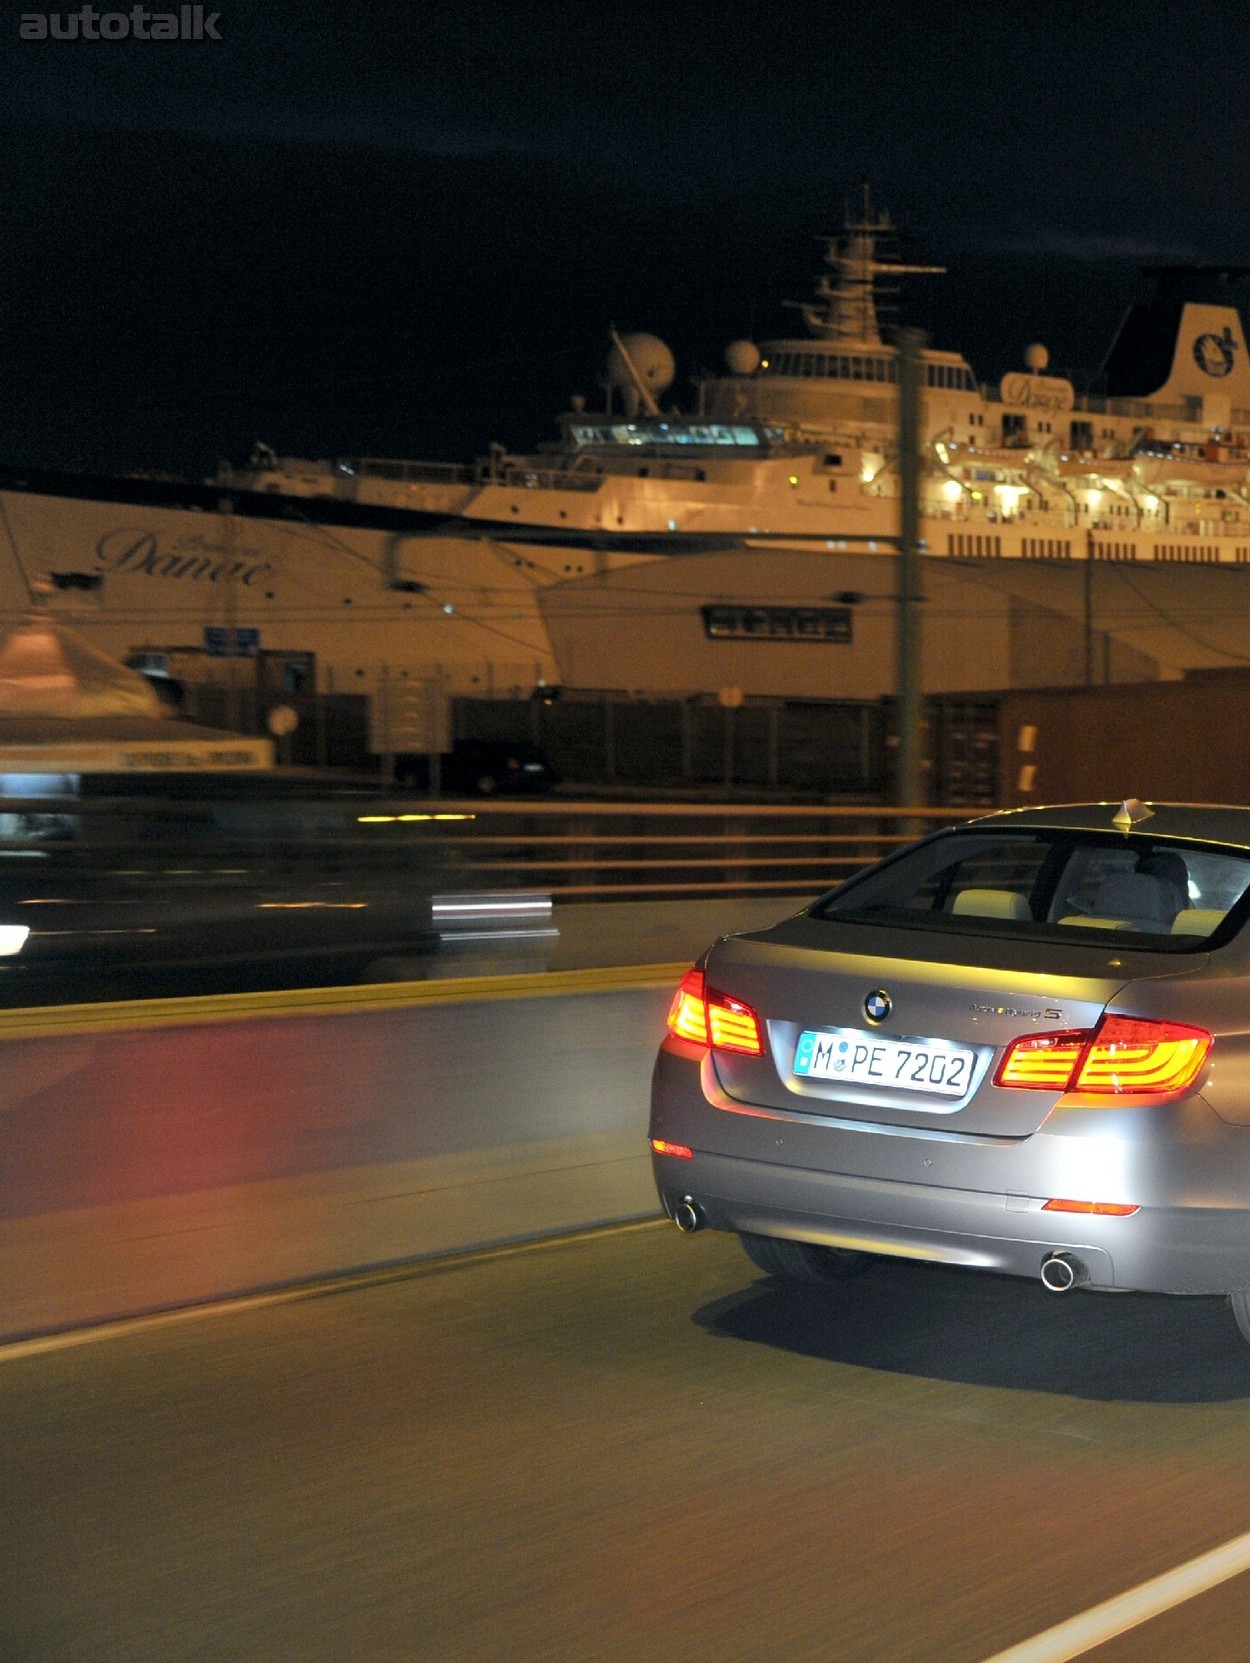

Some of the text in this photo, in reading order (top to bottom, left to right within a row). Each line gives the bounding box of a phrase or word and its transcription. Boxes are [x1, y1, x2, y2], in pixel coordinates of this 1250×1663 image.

[968, 1003, 1042, 1018] AcHybrid
[813, 1041, 966, 1087] M PE 7202
